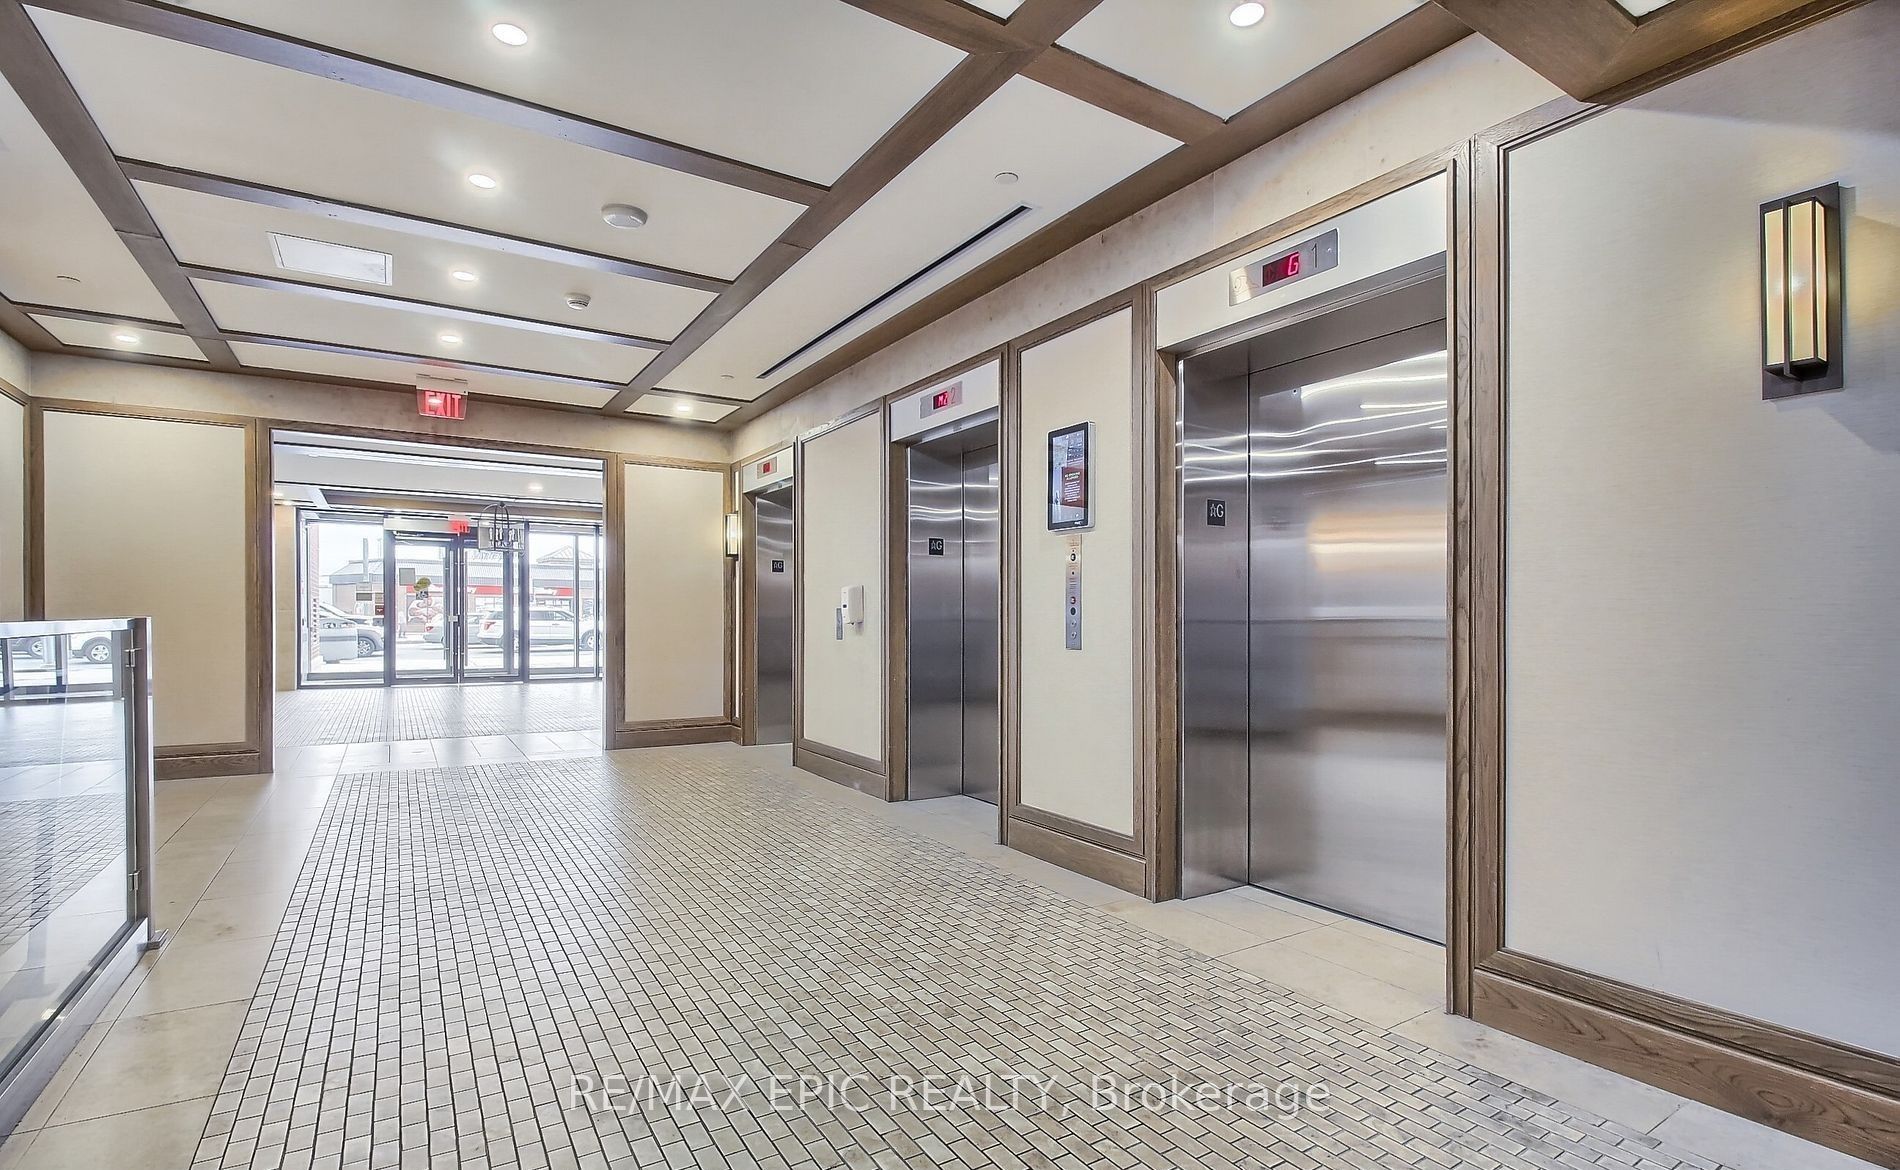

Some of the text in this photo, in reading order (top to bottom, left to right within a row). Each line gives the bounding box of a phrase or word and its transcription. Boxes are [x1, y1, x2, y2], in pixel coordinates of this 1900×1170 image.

[1287, 253, 1300, 276] G
[1311, 243, 1318, 268] 1
[425, 391, 462, 418] EXIT
